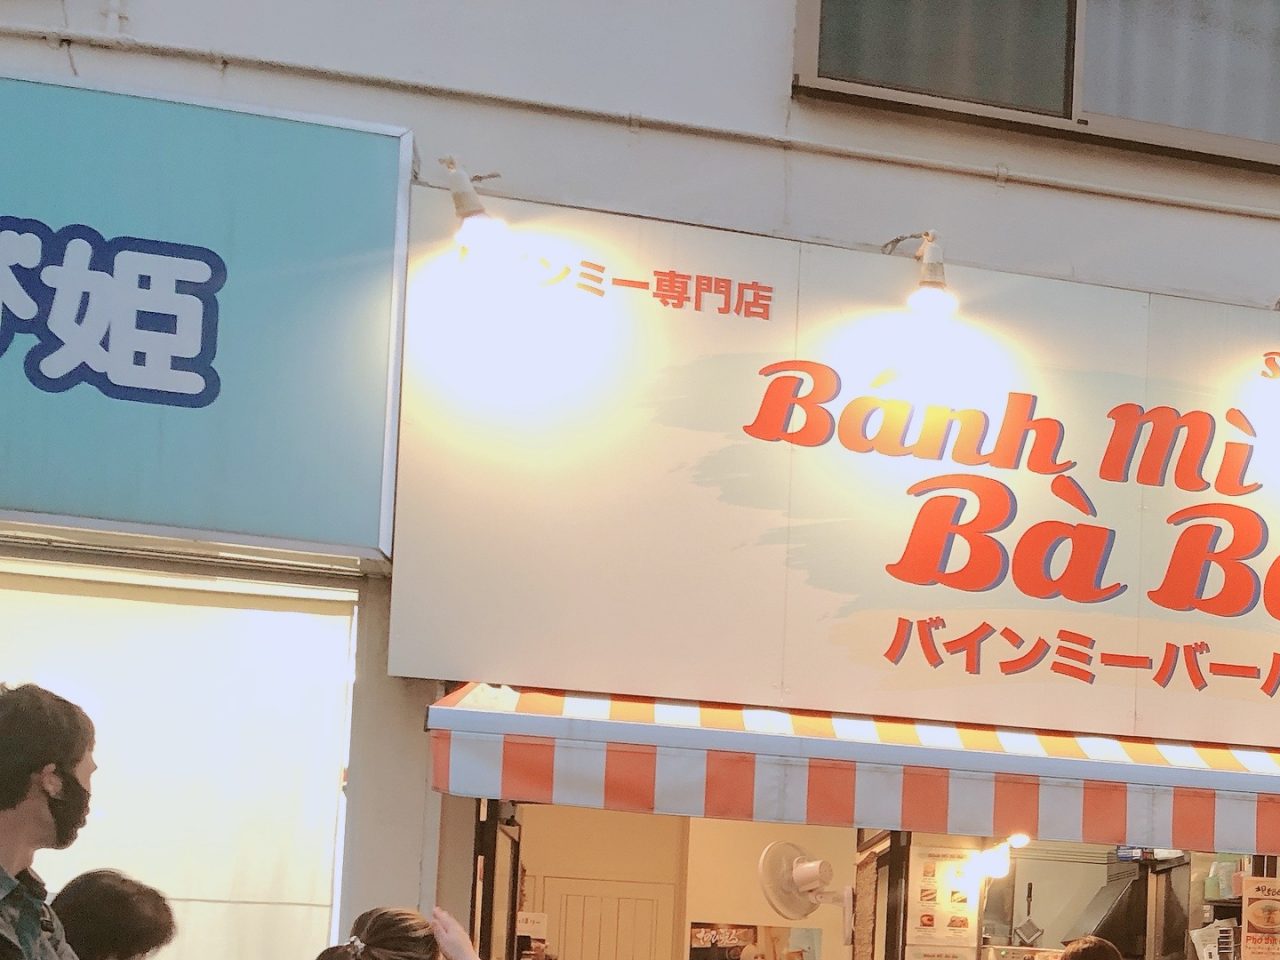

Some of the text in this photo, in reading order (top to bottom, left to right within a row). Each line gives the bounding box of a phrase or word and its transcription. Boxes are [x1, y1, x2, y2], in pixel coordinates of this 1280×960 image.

[495, 250, 774, 321] ンミー専門店
[742, 359, 1077, 475] Bánh
[885, 473, 1129, 604] Bà
